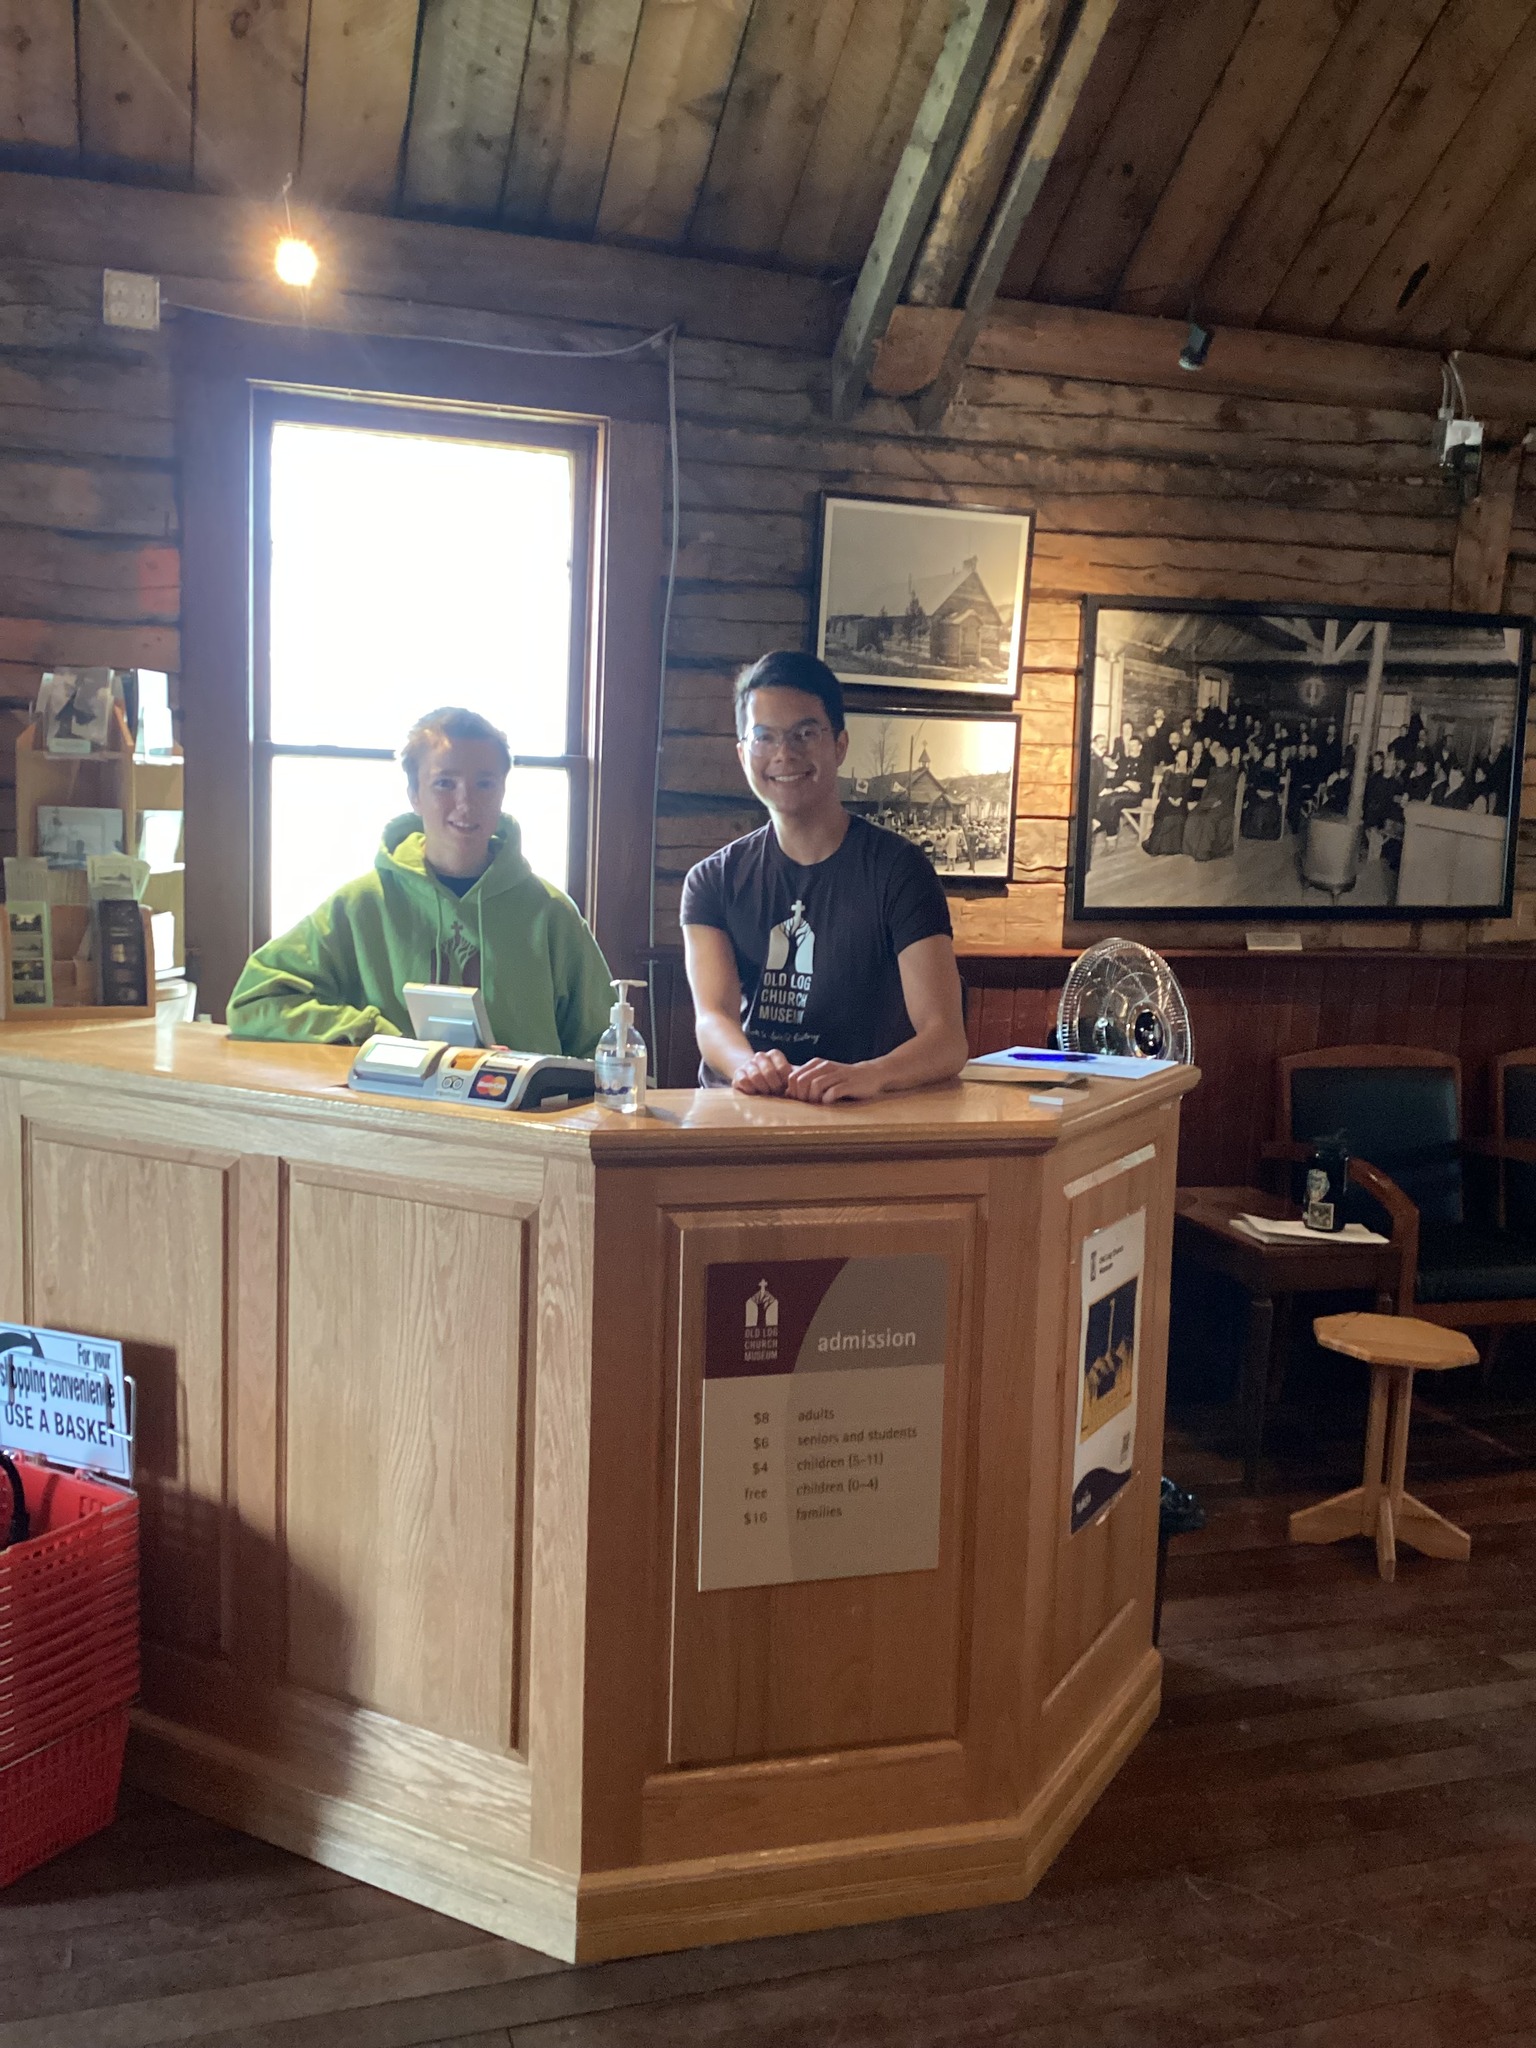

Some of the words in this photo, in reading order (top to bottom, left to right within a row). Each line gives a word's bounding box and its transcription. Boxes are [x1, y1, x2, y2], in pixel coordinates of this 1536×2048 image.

[763, 972, 787, 987] OLD
[790, 974, 811, 991] LOG
[761, 989, 808, 1008] CHURCH
[744, 1328, 760, 1338] OLD
[763, 1327, 778, 1337] LOG
[818, 1328, 916, 1351] admission
[744, 1339, 778, 1350] CHURCH
[77, 1343, 91, 1365] For
[93, 1350, 112, 1371] your
[744, 1350, 778, 1361] MUSEUM
[50, 1372, 115, 1408] conveniene
[5, 1404, 34, 1429] USE
[39, 1410, 50, 1433] A
[753, 1412, 769, 1425] $8
[798, 1408, 835, 1421] adults
[753, 1437, 769, 1450] $6
[798, 1433, 839, 1446] seniors
[843, 1429, 864, 1443] and
[868, 1427, 917, 1440] students
[752, 1461, 768, 1475] $4
[797, 1456, 844, 1471] children
[744, 1487, 768, 1500] free
[796, 1481, 843, 1496] children
[743, 1511, 768, 1525] $16
[796, 1505, 842, 1520] families
